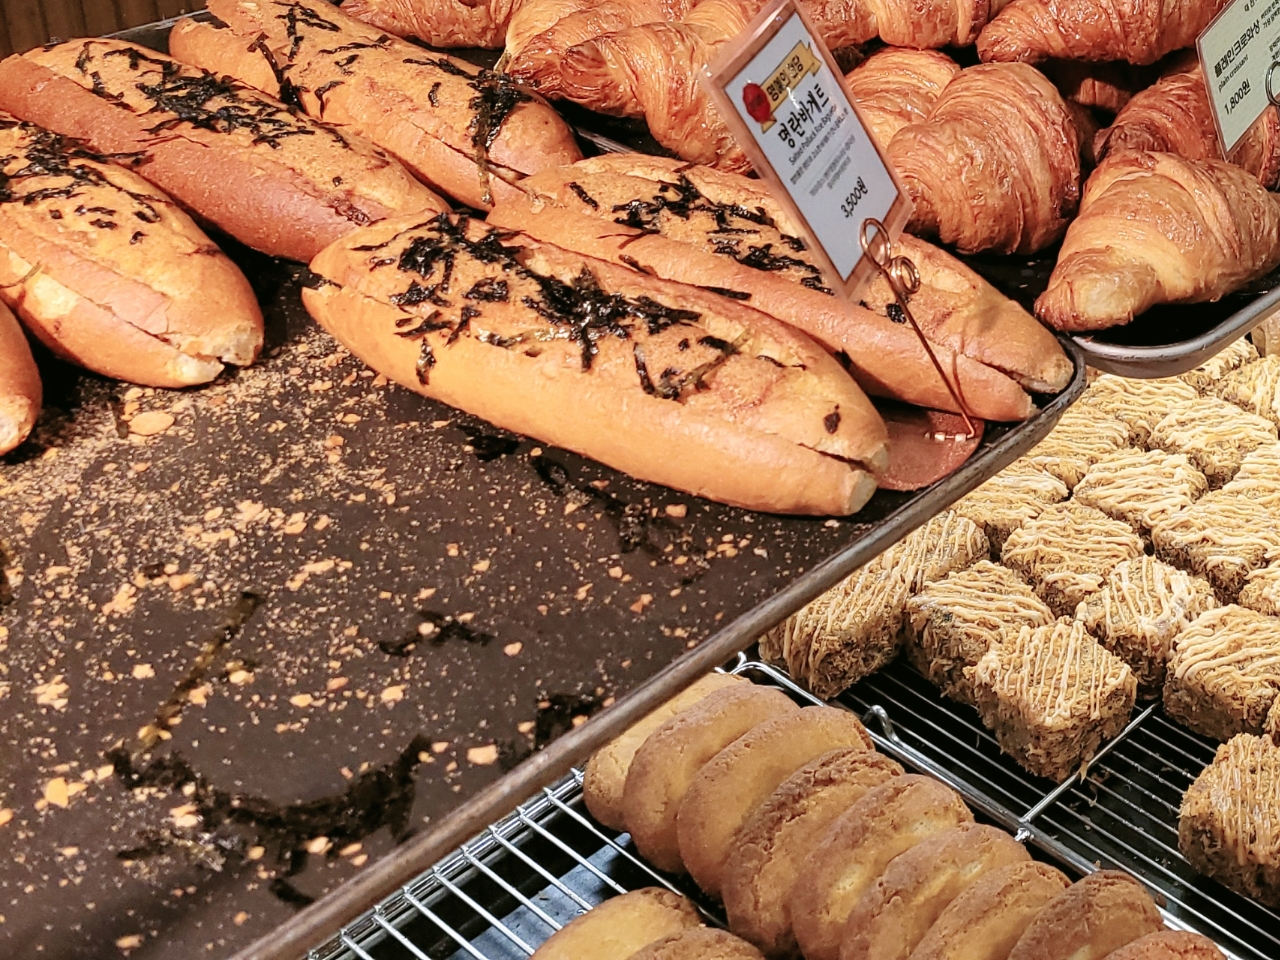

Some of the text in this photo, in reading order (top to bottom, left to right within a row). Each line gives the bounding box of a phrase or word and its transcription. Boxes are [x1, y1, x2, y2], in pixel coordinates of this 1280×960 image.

[1214, 19, 1260, 78] 플레인크로와상
[1218, 75, 1229, 93] plain
[1224, 78, 1250, 115] 1,800원
[777, 82, 829, 150] 명란바게트
[840, 176, 868, 219] 3,500원
